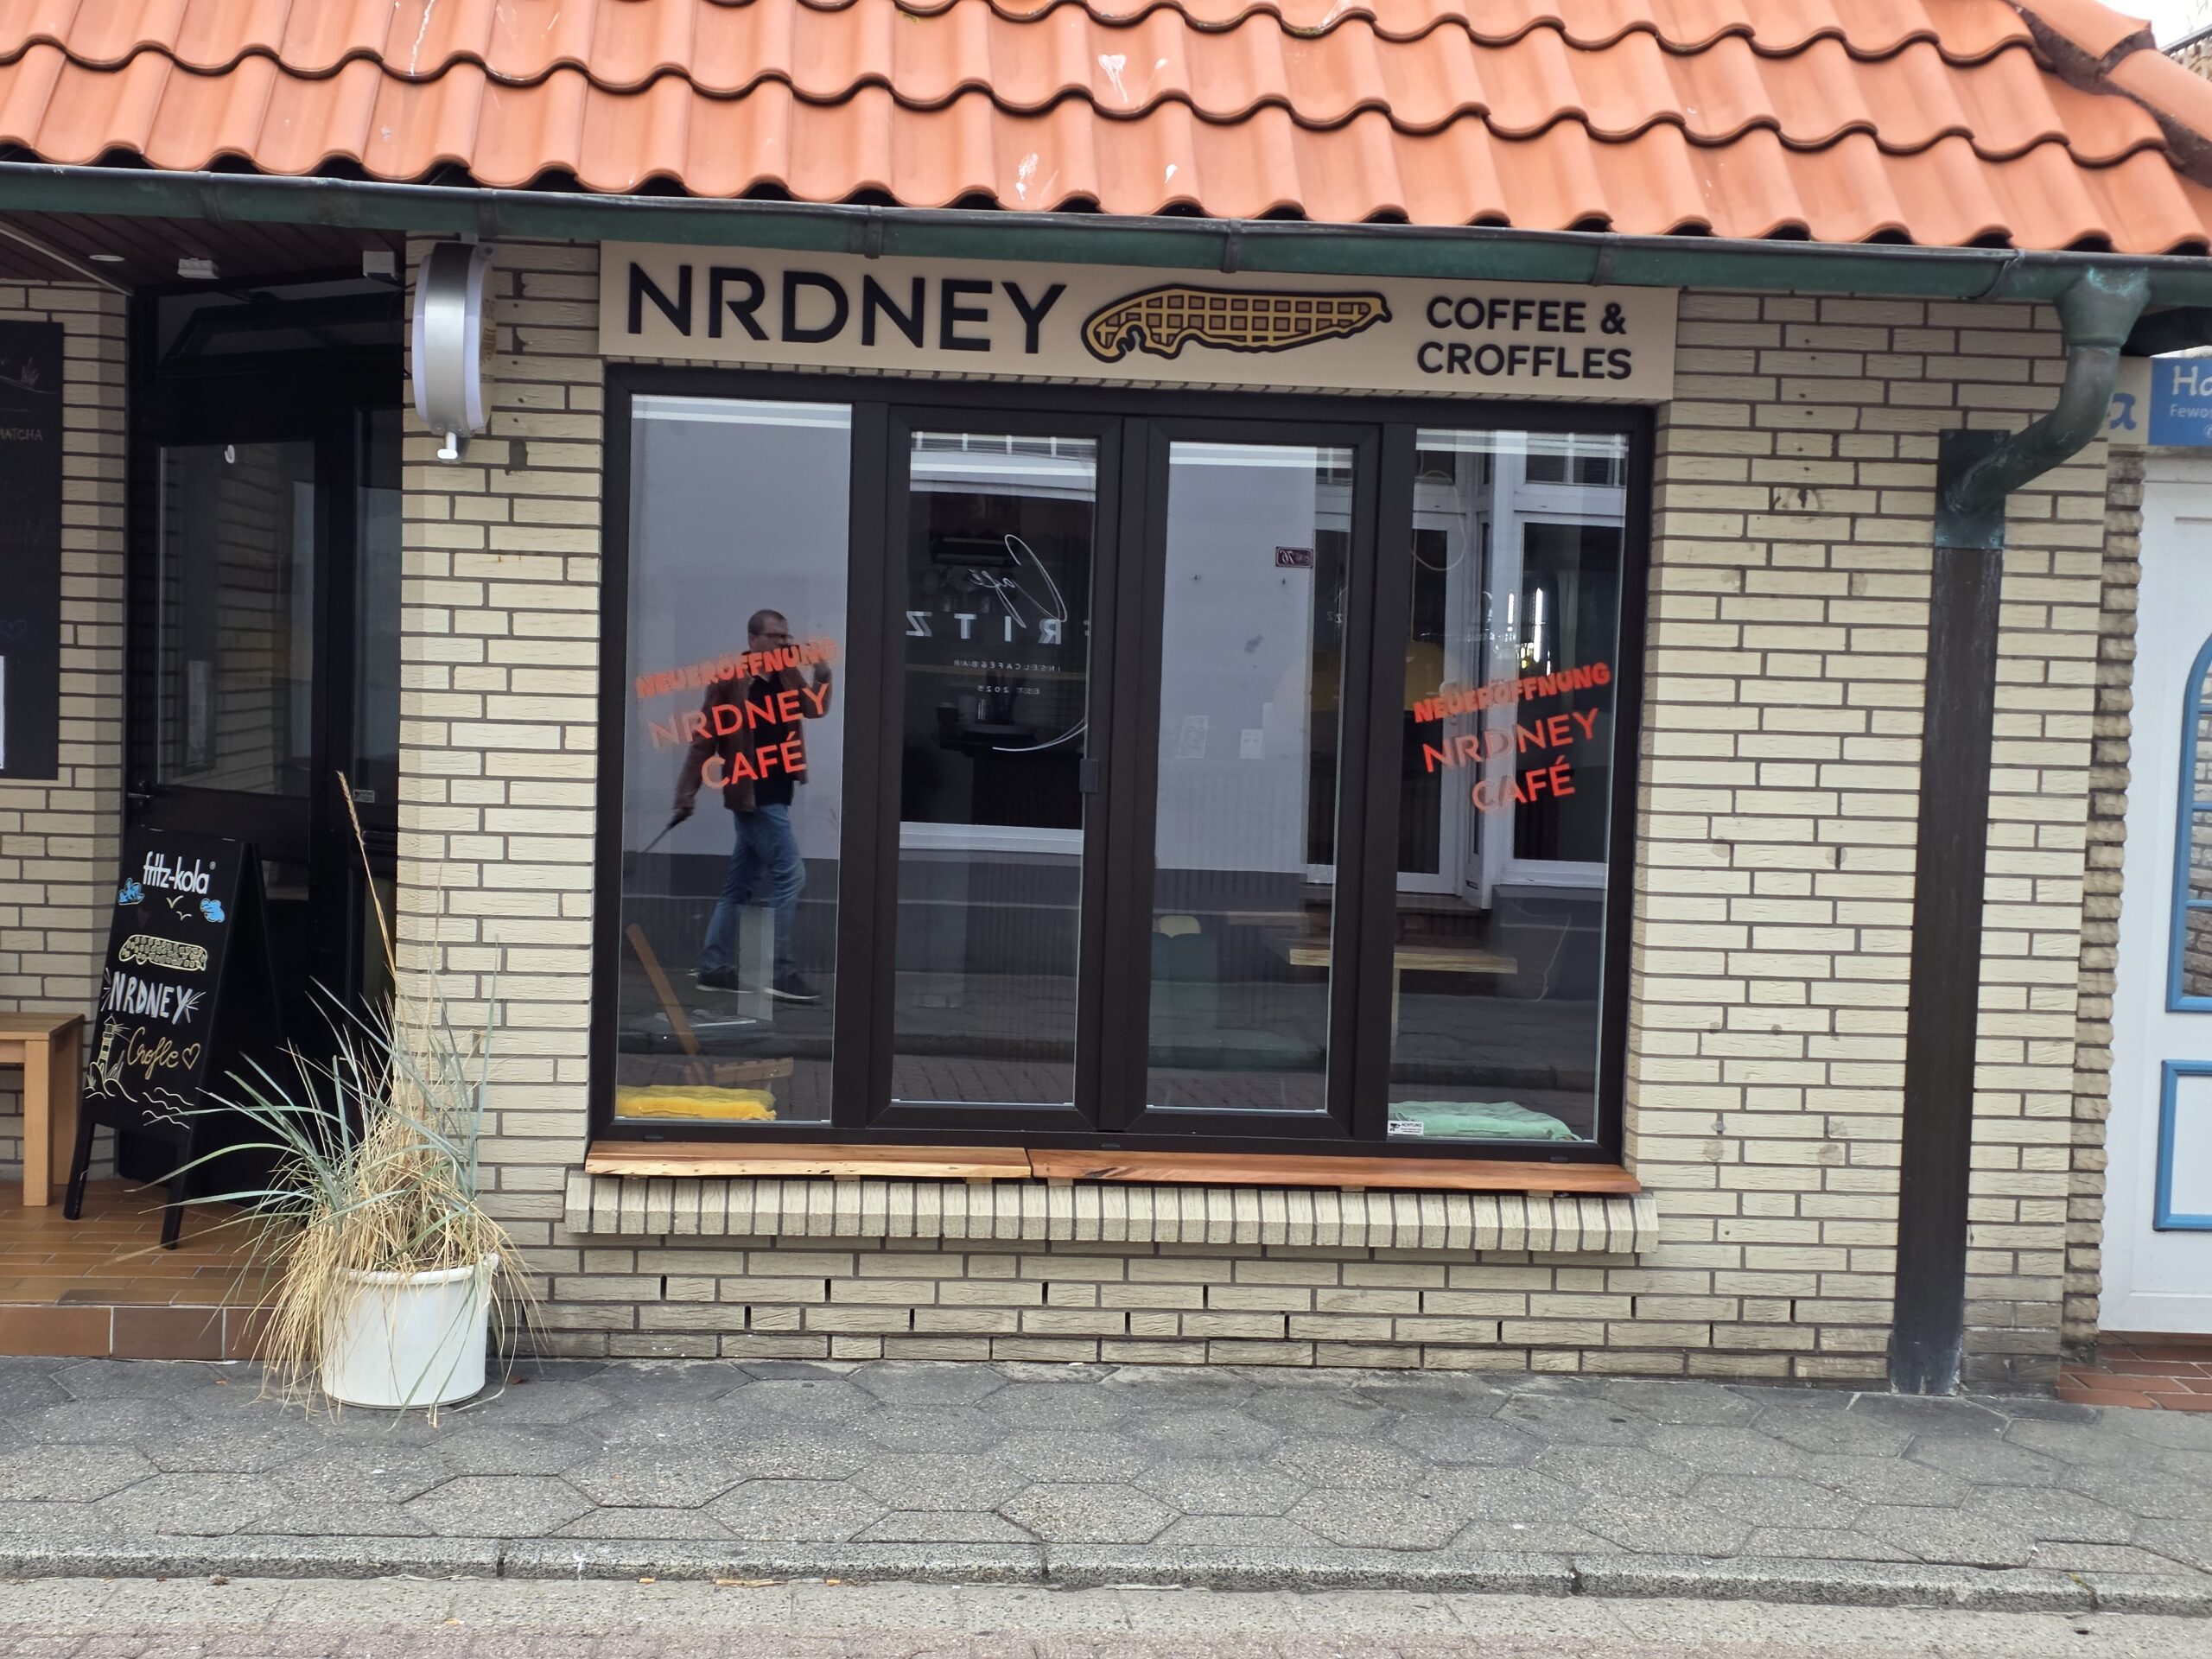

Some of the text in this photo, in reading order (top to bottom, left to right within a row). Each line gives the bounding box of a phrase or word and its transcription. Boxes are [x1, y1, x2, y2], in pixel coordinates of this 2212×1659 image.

[627, 262, 1066, 354] NRDNEY
[1427, 296, 1627, 334] COFFEE &
[1417, 341, 1632, 380] CROFFLES
[635, 638, 838, 698] NEUERÖFFNUNG
[1414, 662, 1611, 723] NEUERÖFFNUNG
[649, 683, 830, 750] NRDNEY
[1422, 708, 1599, 772] NRDNEY
[702, 731, 807, 789] CAFÉ
[1471, 755, 1575, 811] CAFÉ
[143, 851, 210, 894] fritz-kola
[108, 970, 193, 1025] NRDNEY
